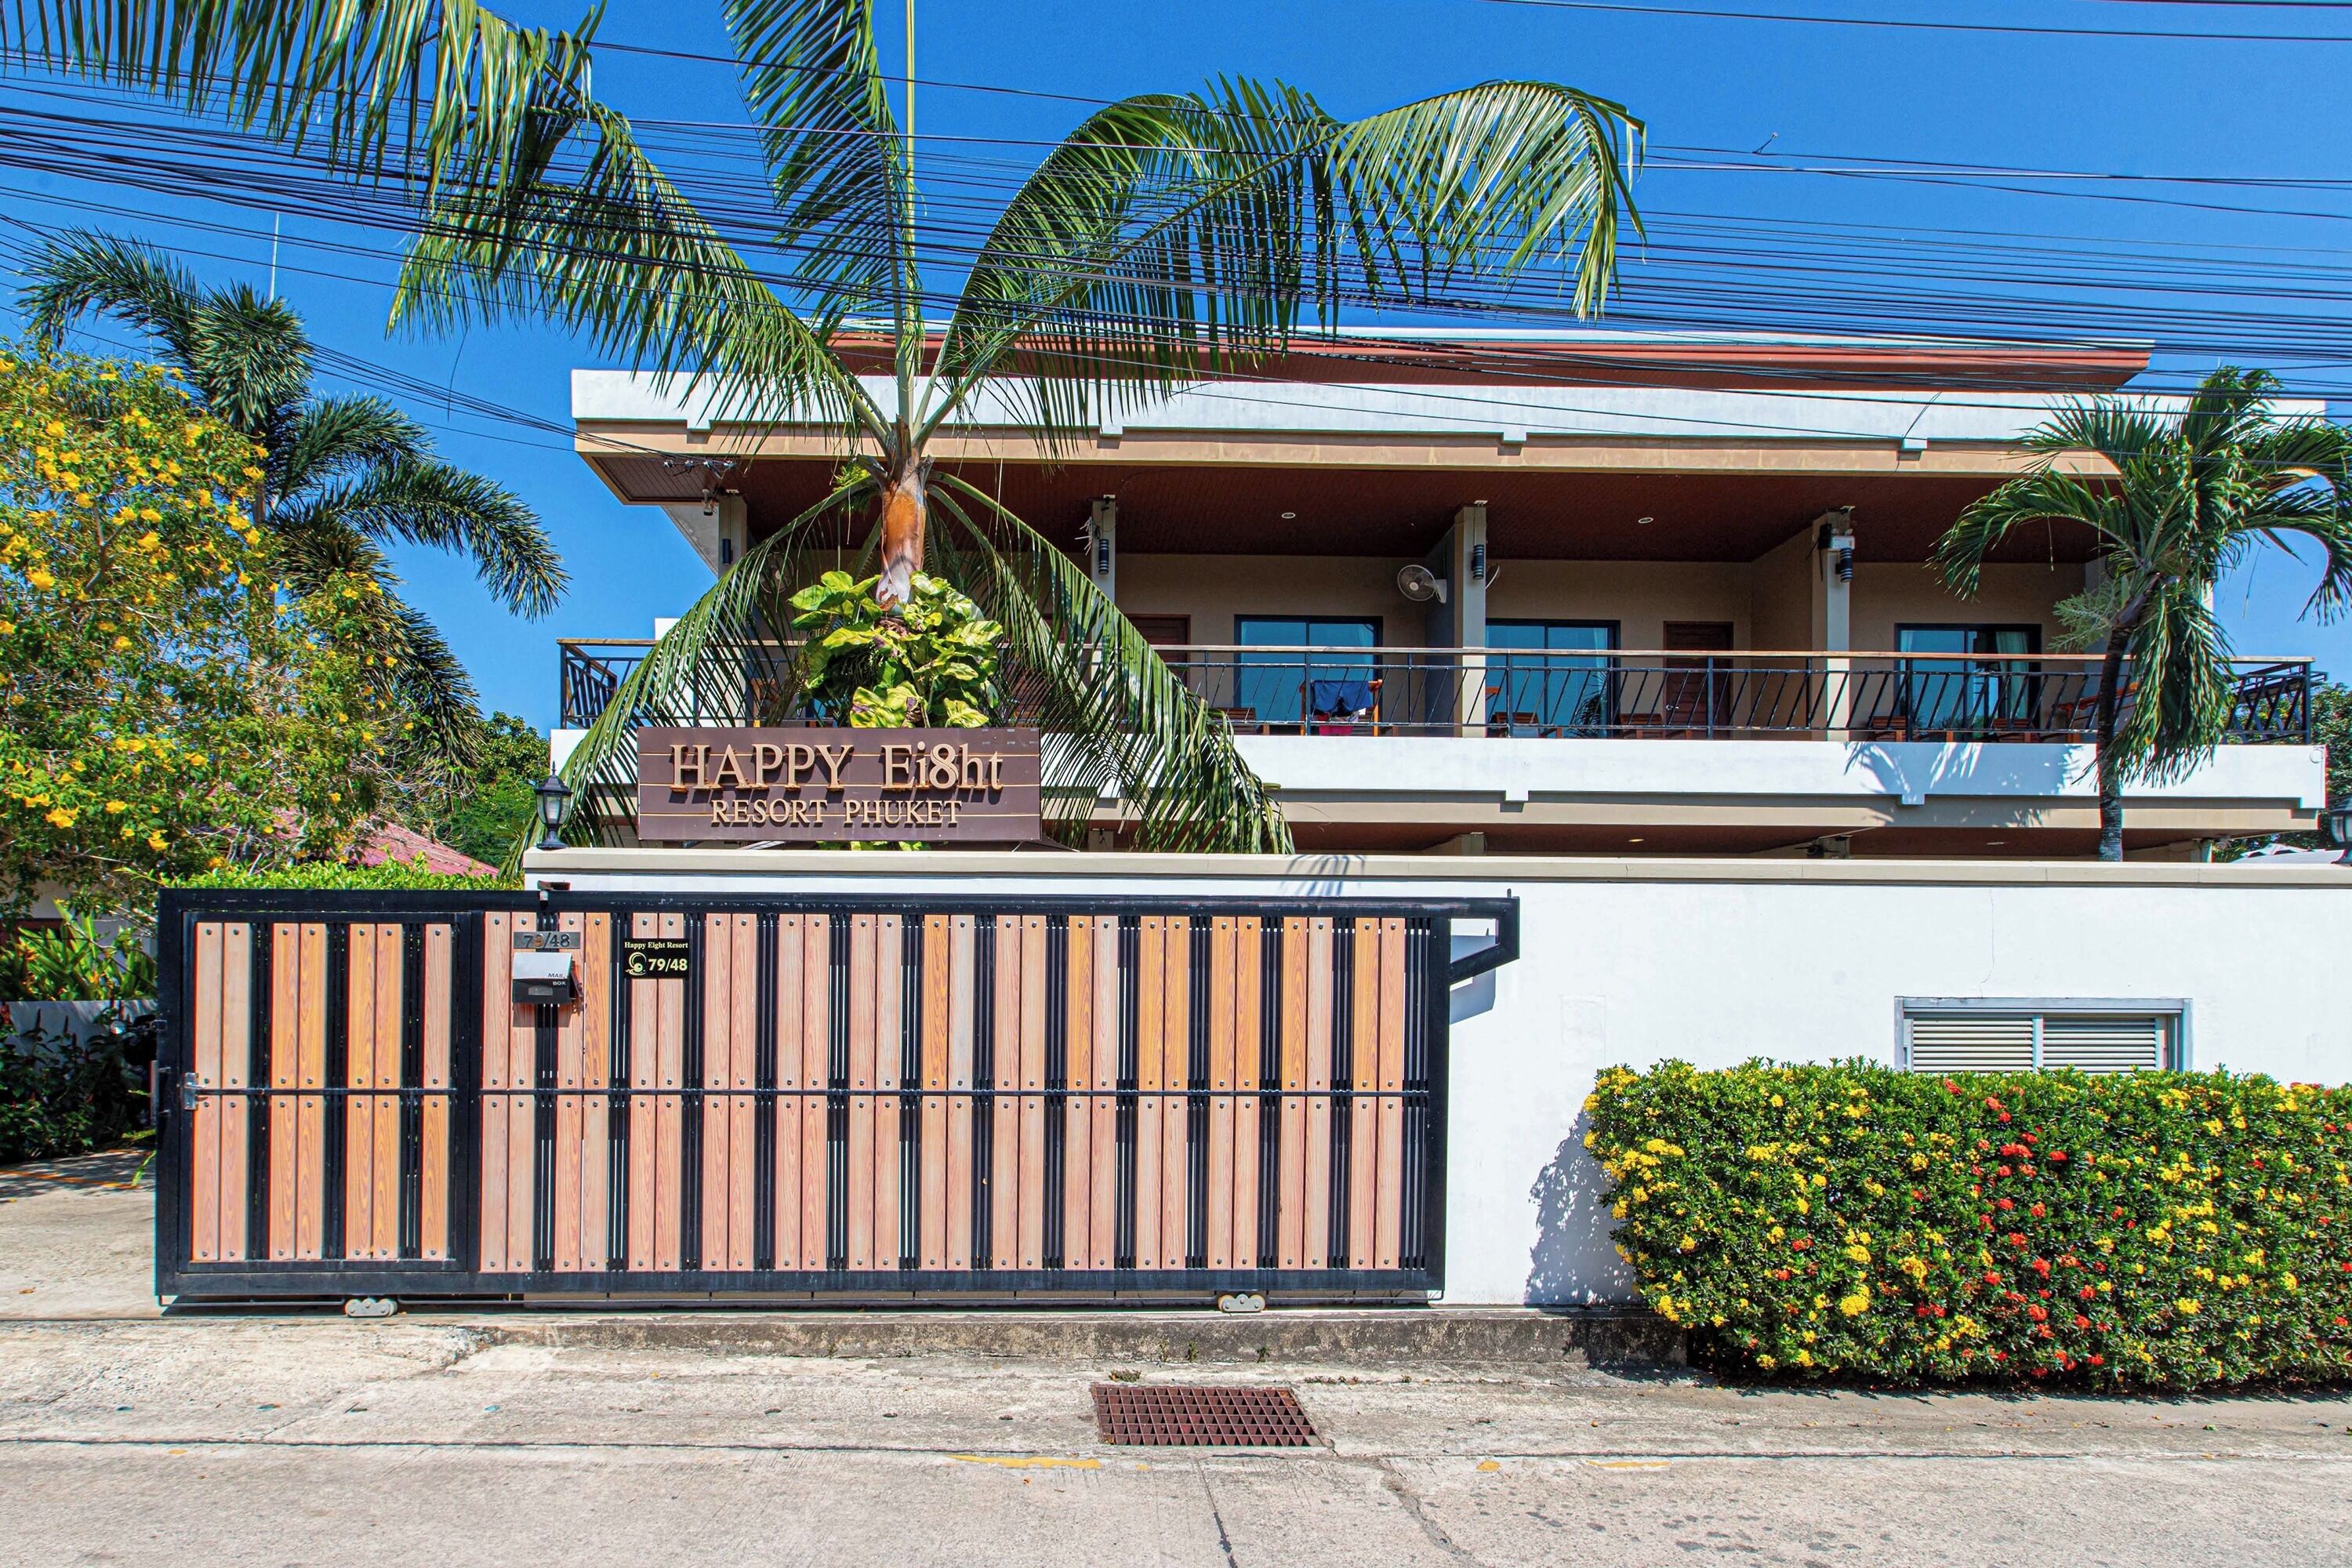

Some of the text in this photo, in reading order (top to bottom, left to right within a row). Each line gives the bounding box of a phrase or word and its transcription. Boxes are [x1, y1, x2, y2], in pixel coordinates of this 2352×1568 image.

[669, 740, 1004, 792] HAPPY Ei8ht
[710, 799, 963, 826] RESORT PHUKET
[648, 958, 688, 972] 79/48
